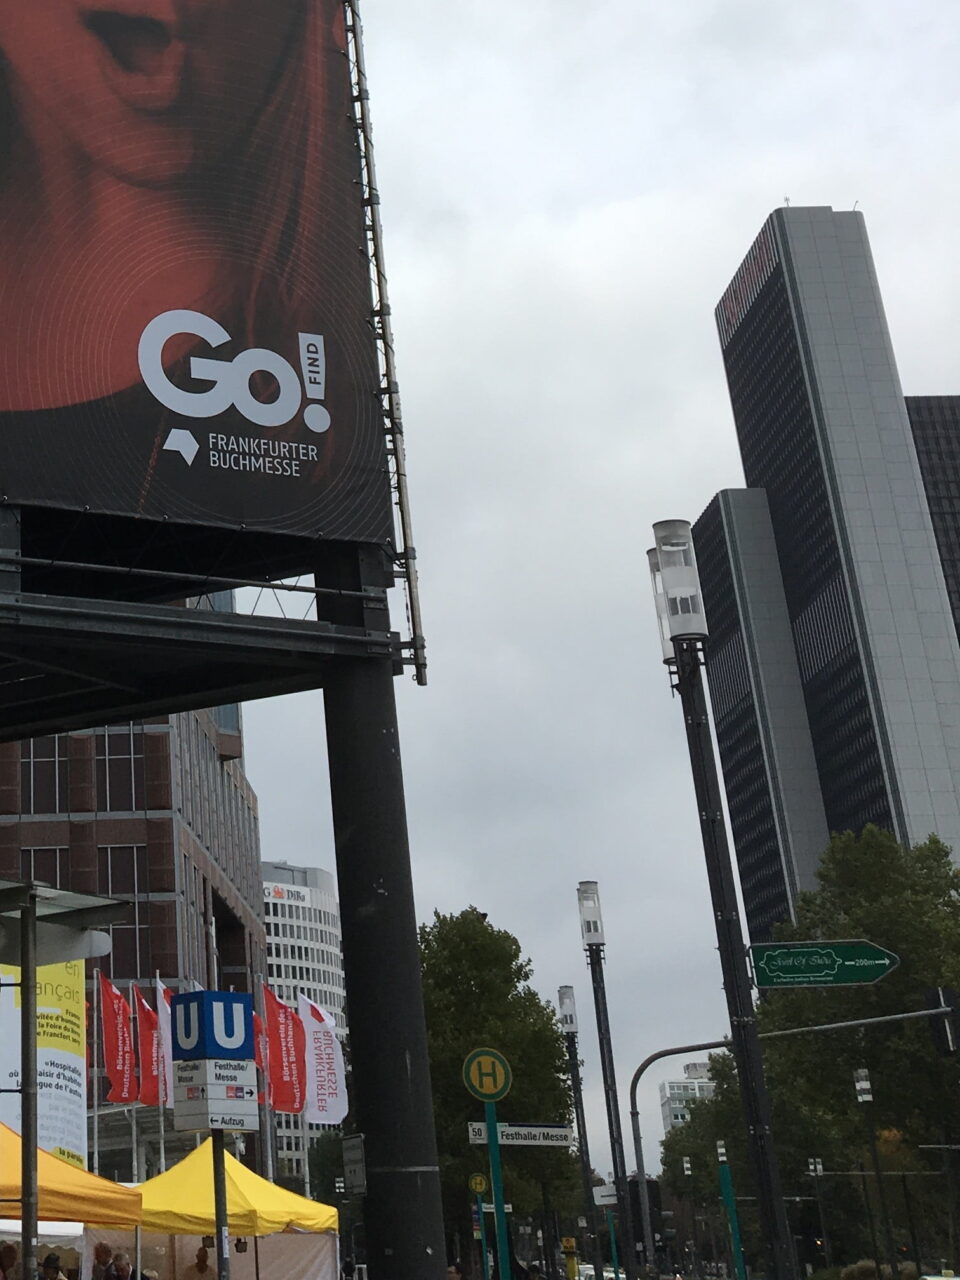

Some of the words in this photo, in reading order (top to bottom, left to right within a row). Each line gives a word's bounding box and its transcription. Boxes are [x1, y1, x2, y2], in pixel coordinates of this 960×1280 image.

[305, 341, 322, 386] FIND
[208, 433, 319, 462] FRANKFURTER
[209, 450, 301, 477] BUCHMESSE
[855, 958, 876, 967] 200m
[36, 980, 80, 1004] ançais
[176, 1001, 199, 1050] U
[212, 1001, 246, 1050] U
[214, 1072, 238, 1082] Messe
[476, 1060, 498, 1089] H
[220, 1116, 245, 1127] Aufzug
[471, 1127, 483, 1137] 50
